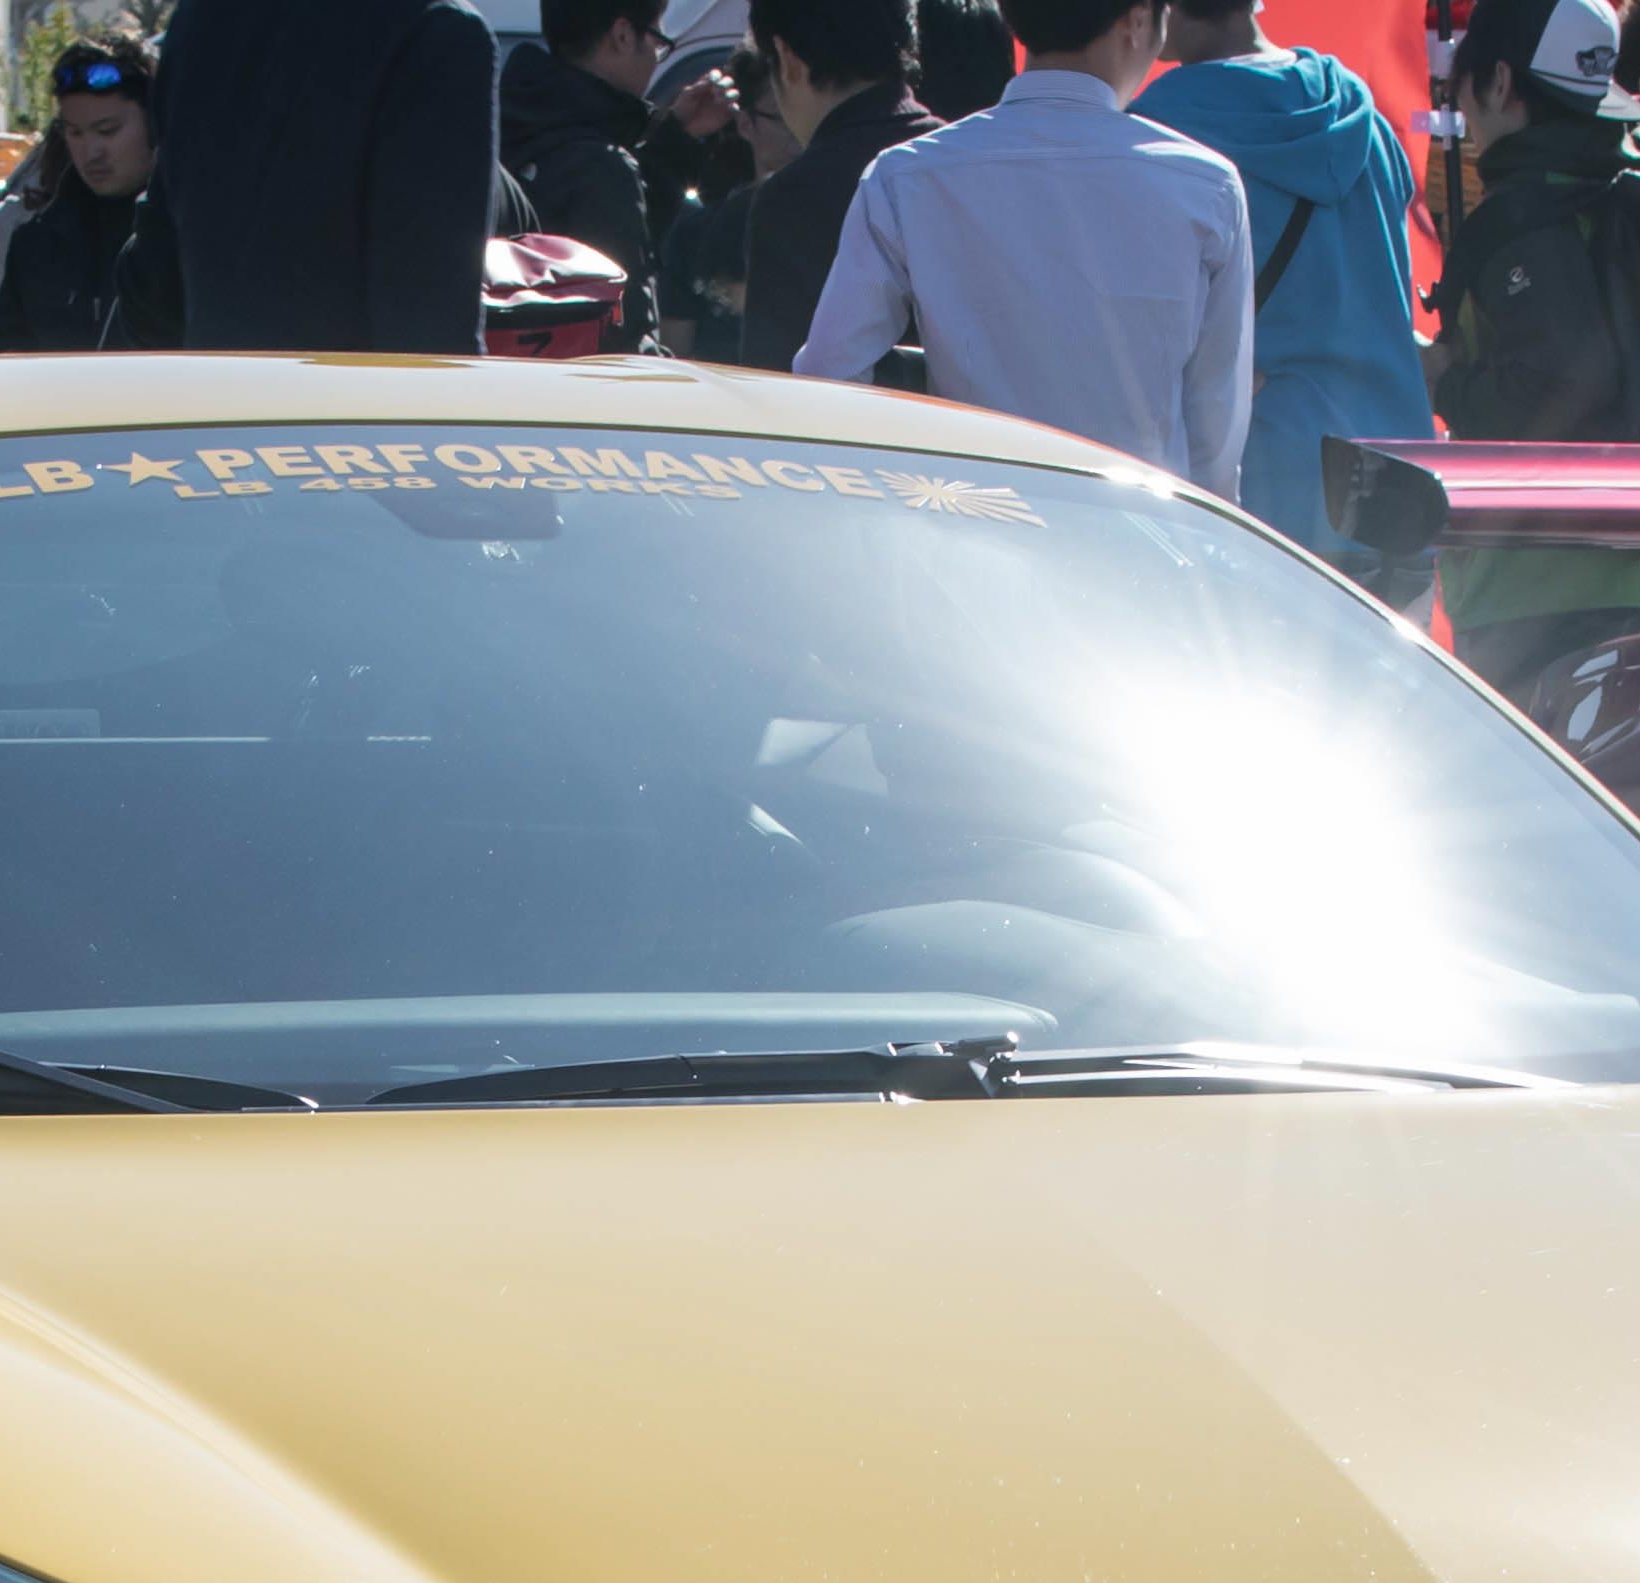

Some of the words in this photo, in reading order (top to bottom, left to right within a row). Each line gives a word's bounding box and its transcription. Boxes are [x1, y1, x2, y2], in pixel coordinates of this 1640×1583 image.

[173, 481, 275, 500] LB
[299, 475, 438, 492] 458
[457, 476, 744, 500] WORKS
[196, 443, 886, 499] PERFORMANCE
